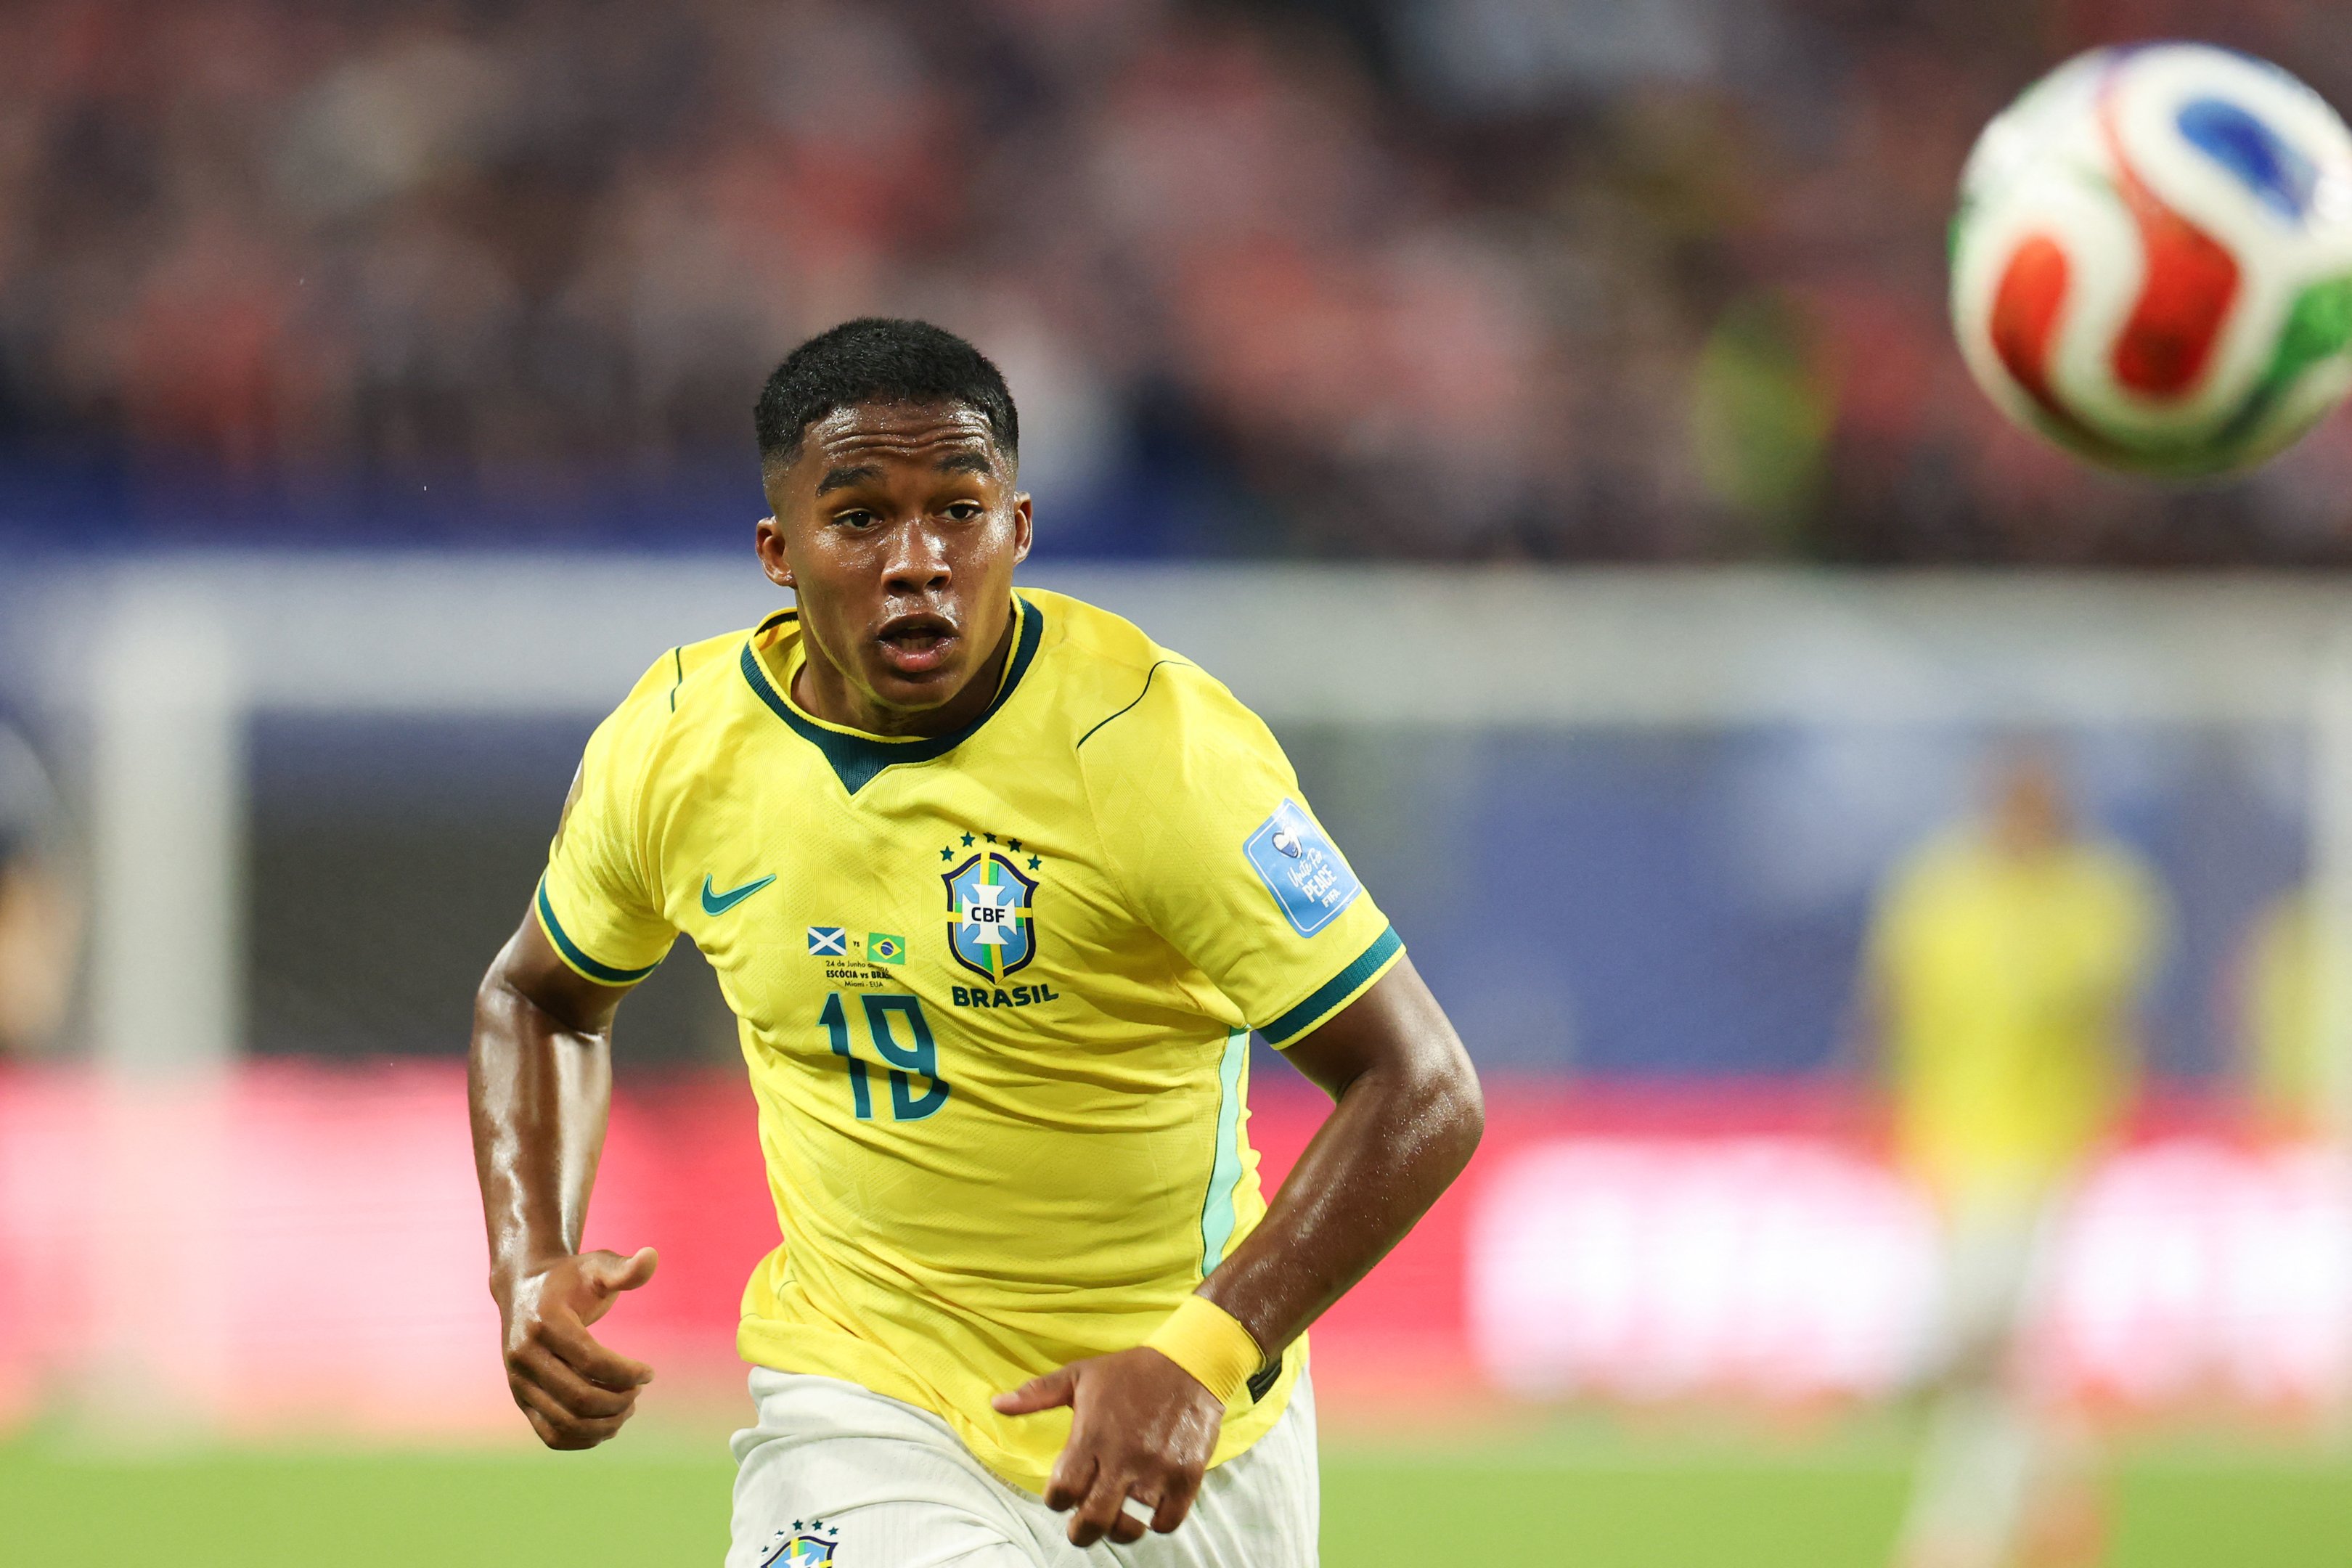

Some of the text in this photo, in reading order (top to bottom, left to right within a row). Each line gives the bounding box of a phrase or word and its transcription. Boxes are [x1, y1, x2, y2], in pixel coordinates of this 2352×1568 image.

[1287, 847, 1323, 888] Unite For
[1302, 864, 1337, 903] PEACE
[1321, 888, 1342, 908] FIFA
[971, 907, 1005, 923] CBF
[826, 968, 858, 979] ESCÓCIA
[952, 984, 1059, 1008] BRASIL
[817, 991, 952, 1122] 19
